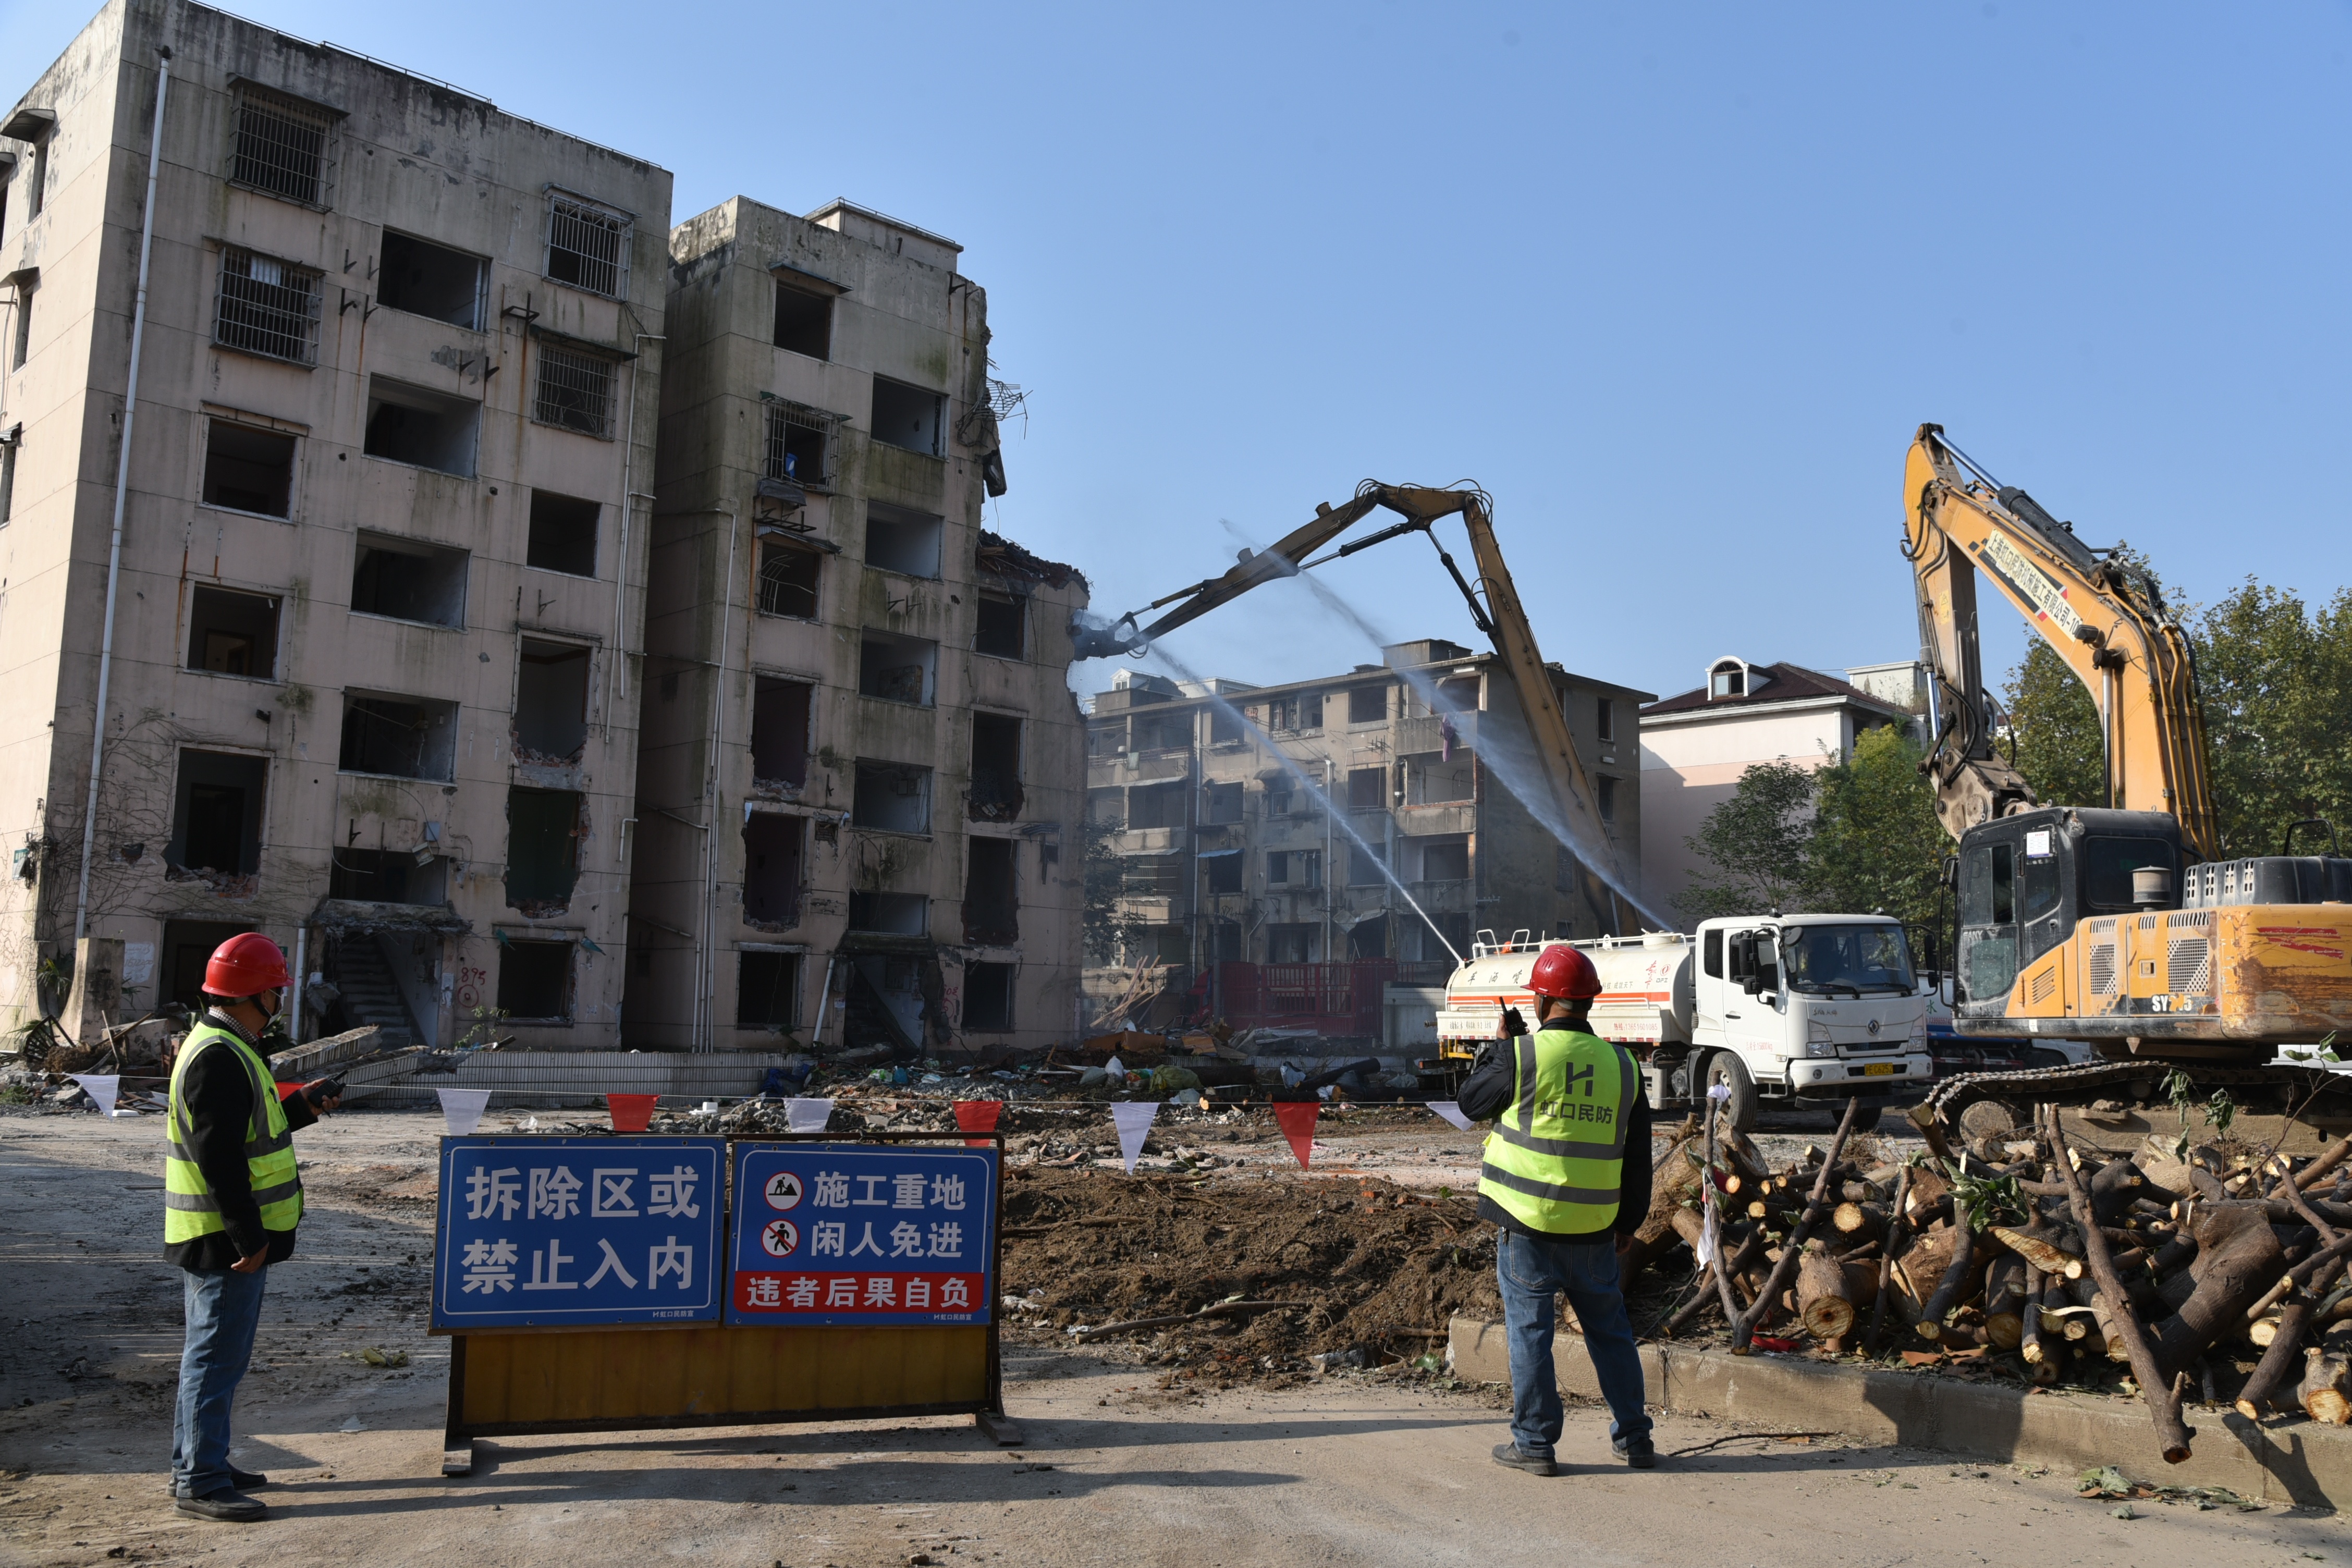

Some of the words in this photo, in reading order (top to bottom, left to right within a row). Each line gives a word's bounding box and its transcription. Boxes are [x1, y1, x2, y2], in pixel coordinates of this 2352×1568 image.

[1926, 999, 1938, 1014] 水
[1539, 1099, 1613, 1124] 虹口民防
[466, 1166, 700, 1221] 拆除区或
[812, 1171, 966, 1210] 施工重地
[811, 1220, 963, 1258] 闲人免进
[461, 1235, 693, 1294] 禁止入内
[747, 1276, 970, 1307] 违者后果自负
